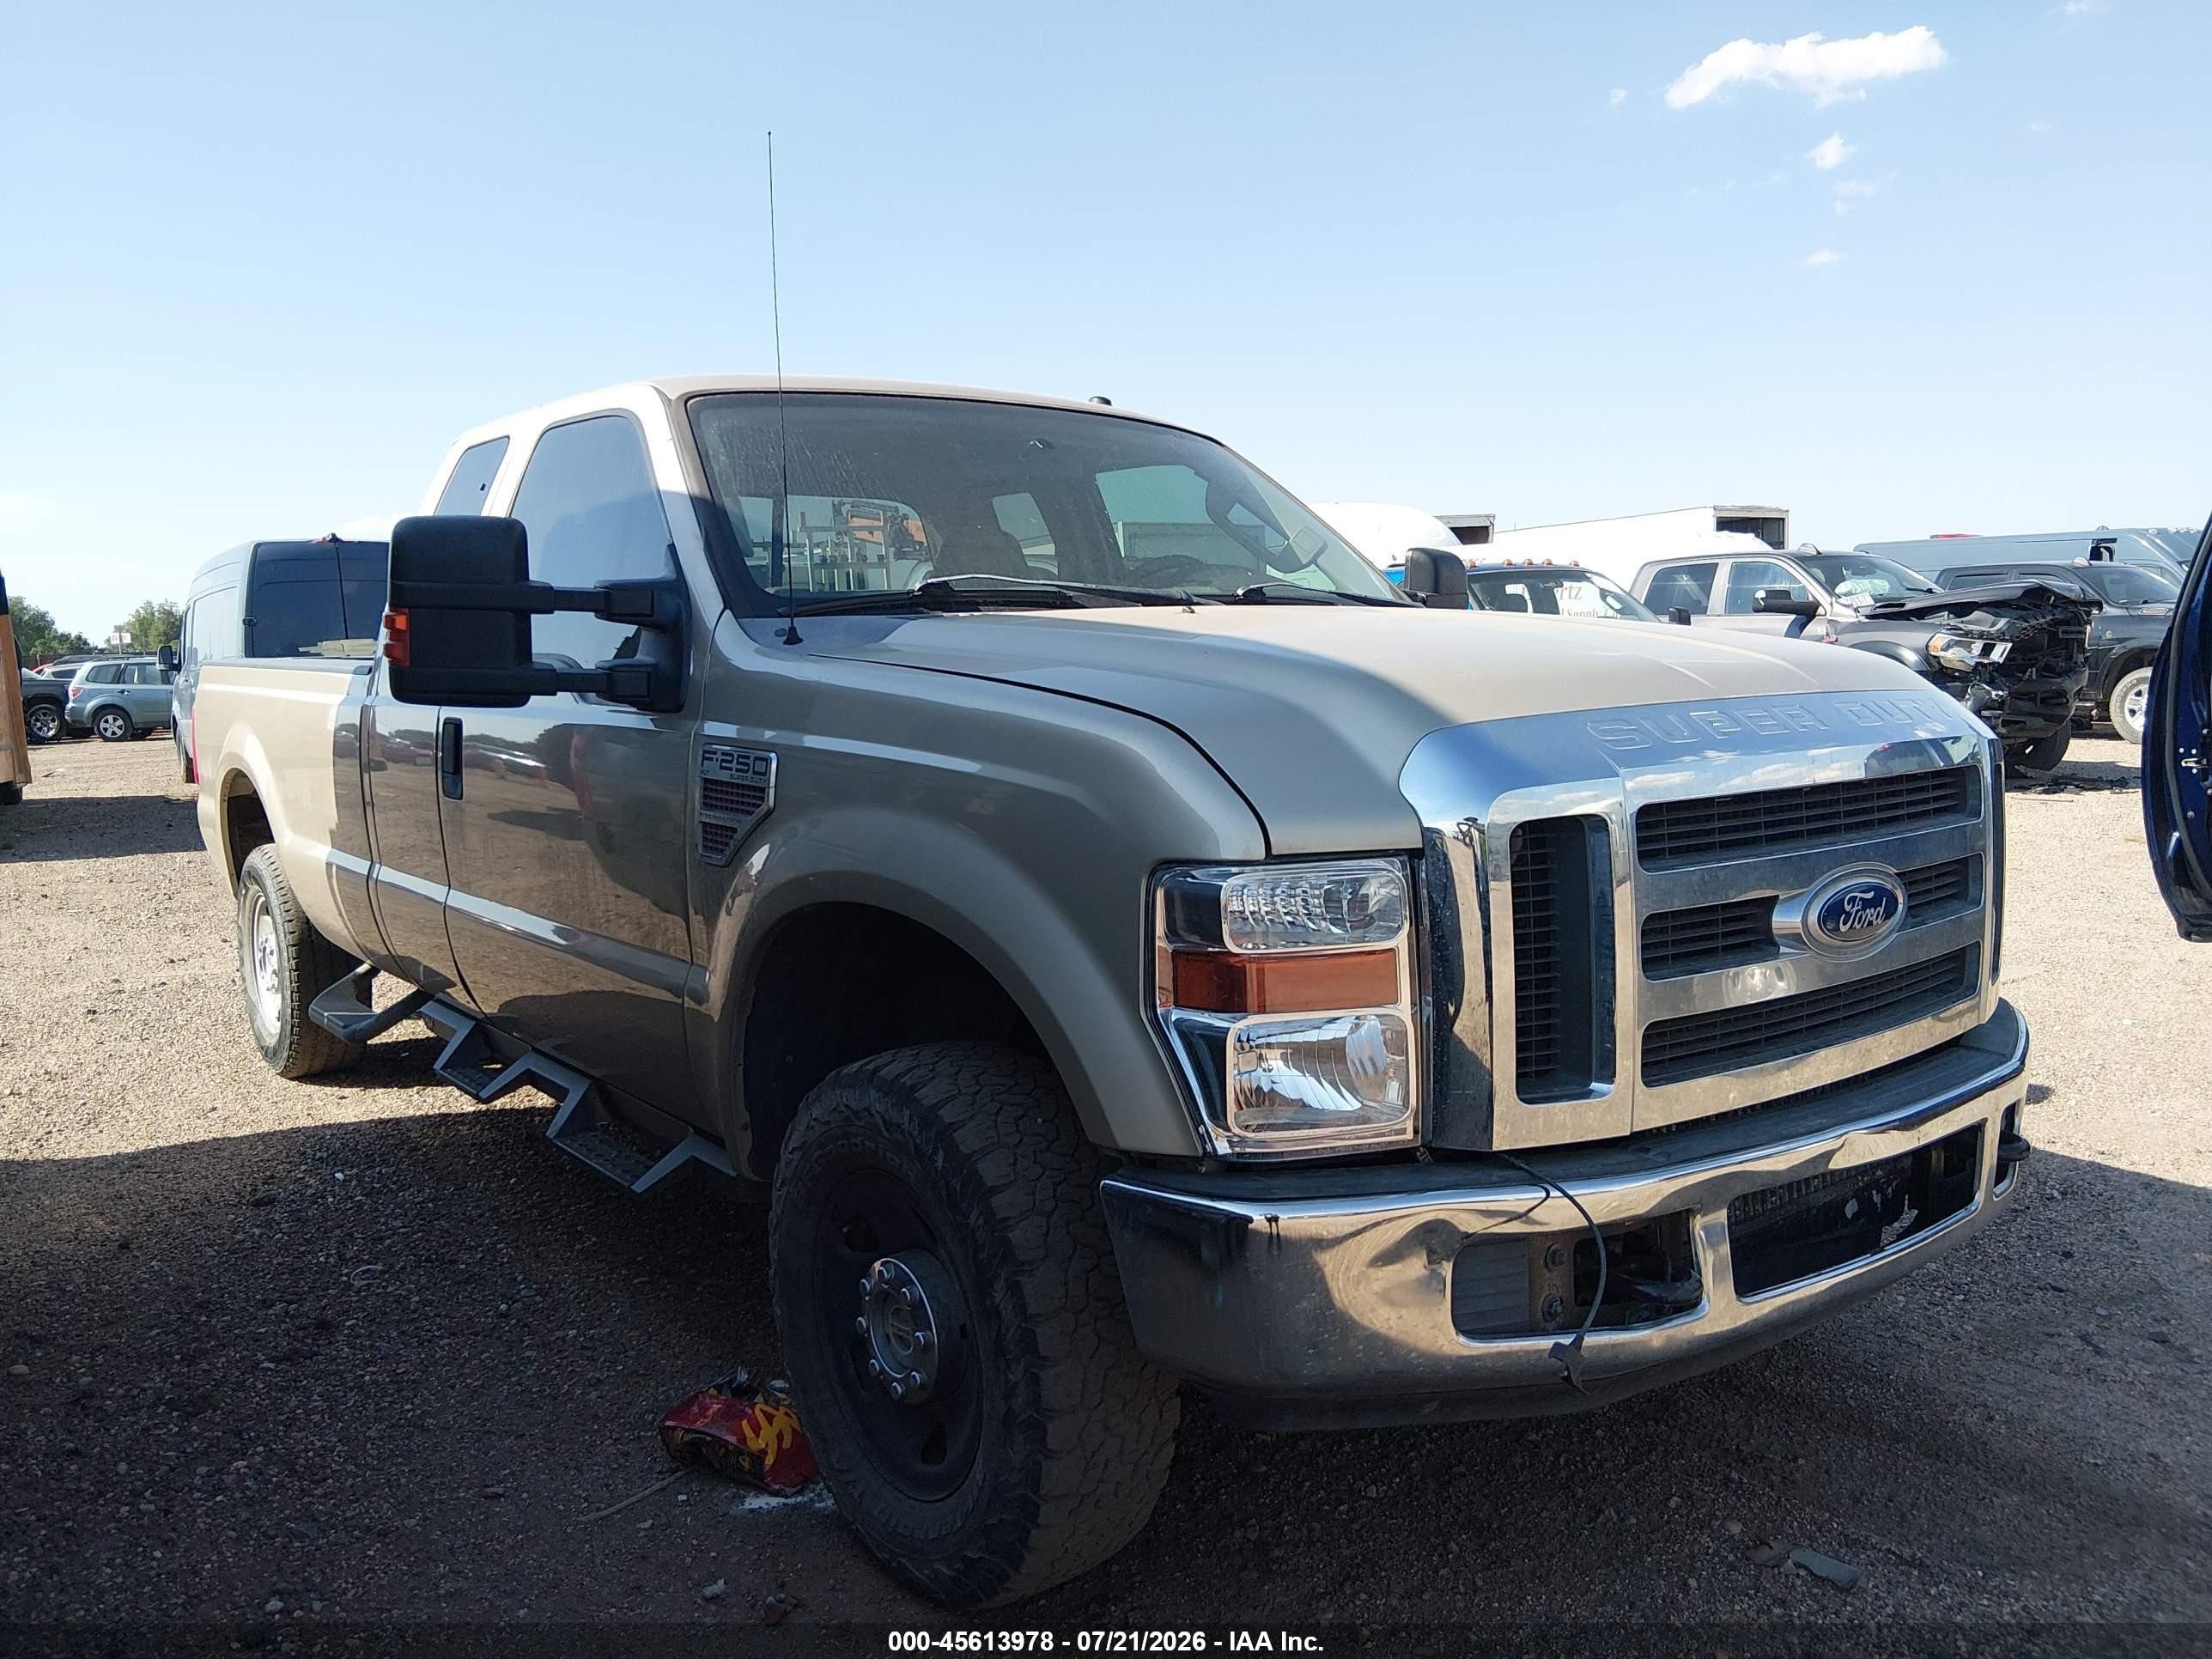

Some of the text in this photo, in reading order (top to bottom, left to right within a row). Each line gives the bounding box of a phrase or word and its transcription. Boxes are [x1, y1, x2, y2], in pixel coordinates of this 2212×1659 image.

[1587, 697, 1954, 750] SUPER DUTY
[1838, 890, 1887, 933] Ford
